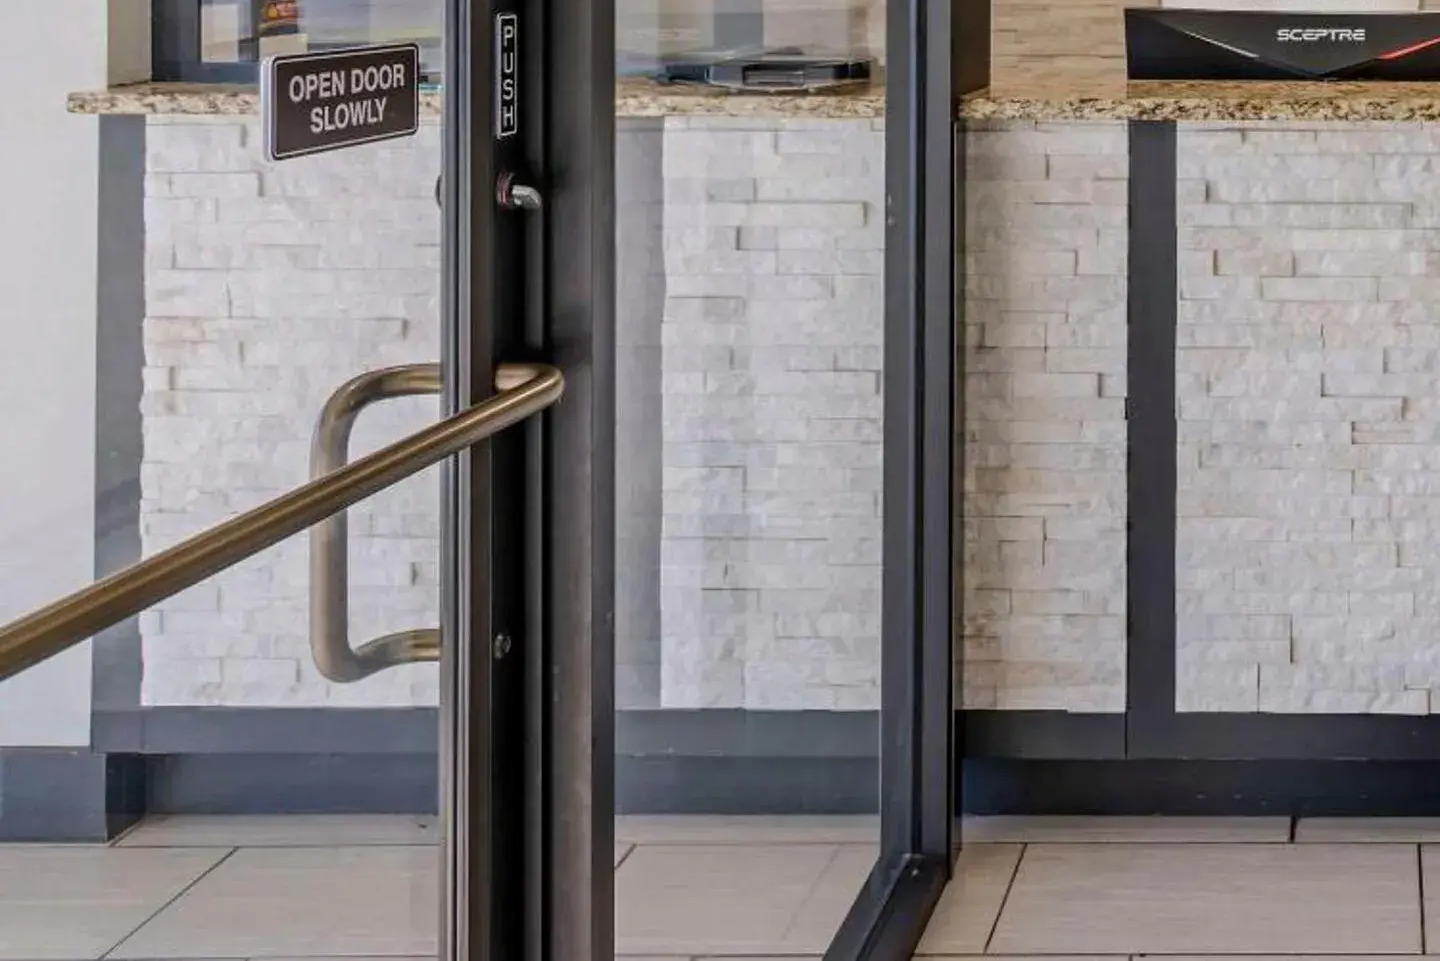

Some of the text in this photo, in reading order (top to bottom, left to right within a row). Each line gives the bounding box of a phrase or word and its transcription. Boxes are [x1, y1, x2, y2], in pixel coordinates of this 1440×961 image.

[1276, 28, 1367, 42] SCEPTRE
[289, 63, 405, 103] OPEN DOOR
[503, 25, 514, 128] PUSH
[310, 96, 387, 133] SLOWLY
